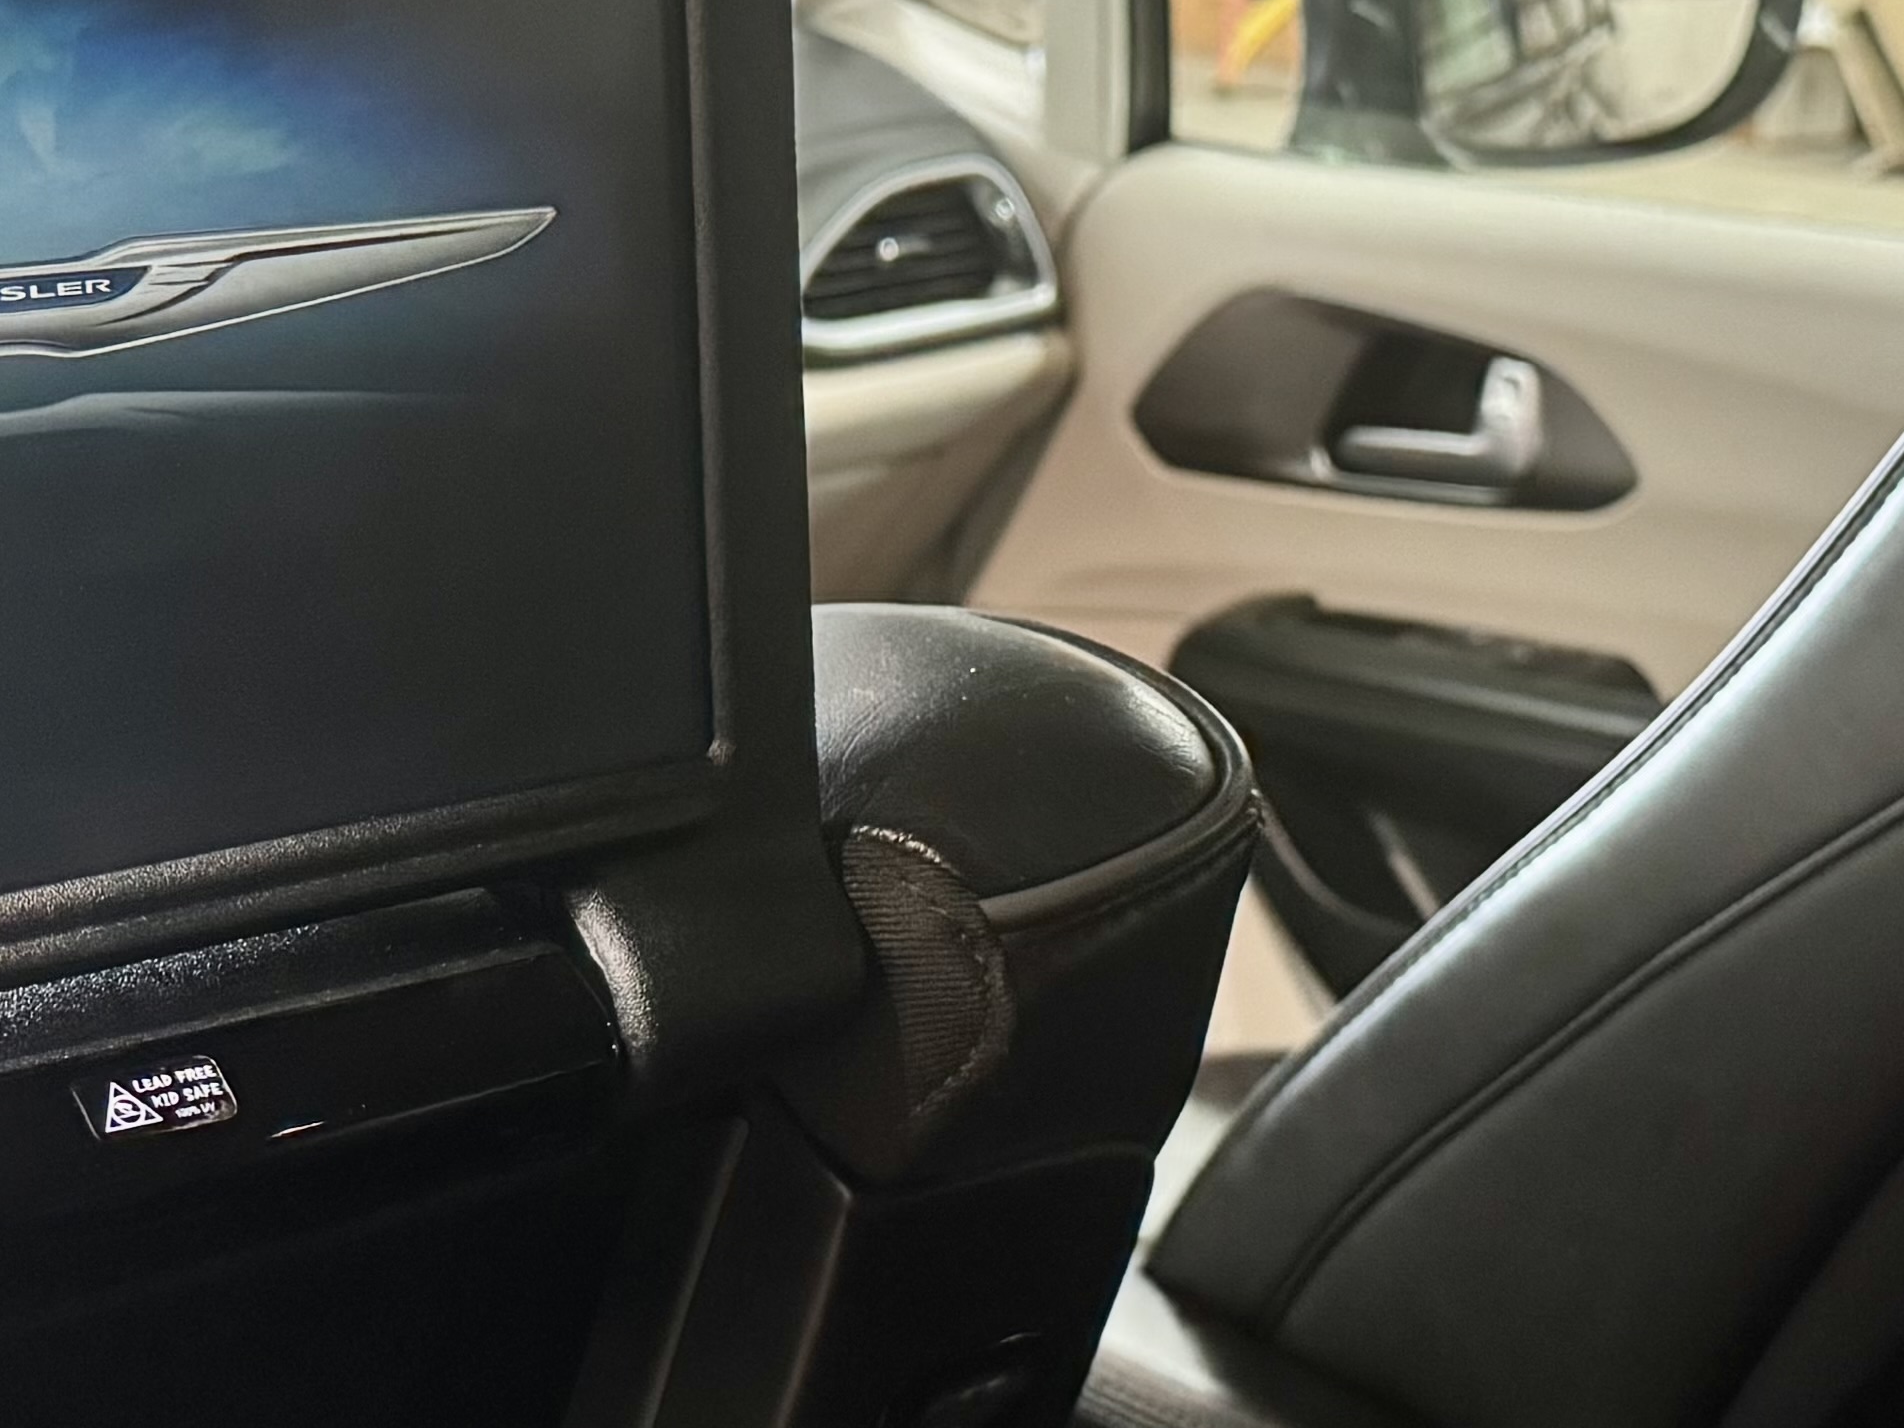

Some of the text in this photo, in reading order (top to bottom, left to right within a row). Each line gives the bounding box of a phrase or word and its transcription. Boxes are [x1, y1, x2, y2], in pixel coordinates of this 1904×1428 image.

[132, 1065, 217, 1093] LEAD FREE
[151, 1083, 223, 1108] KID SAFE
